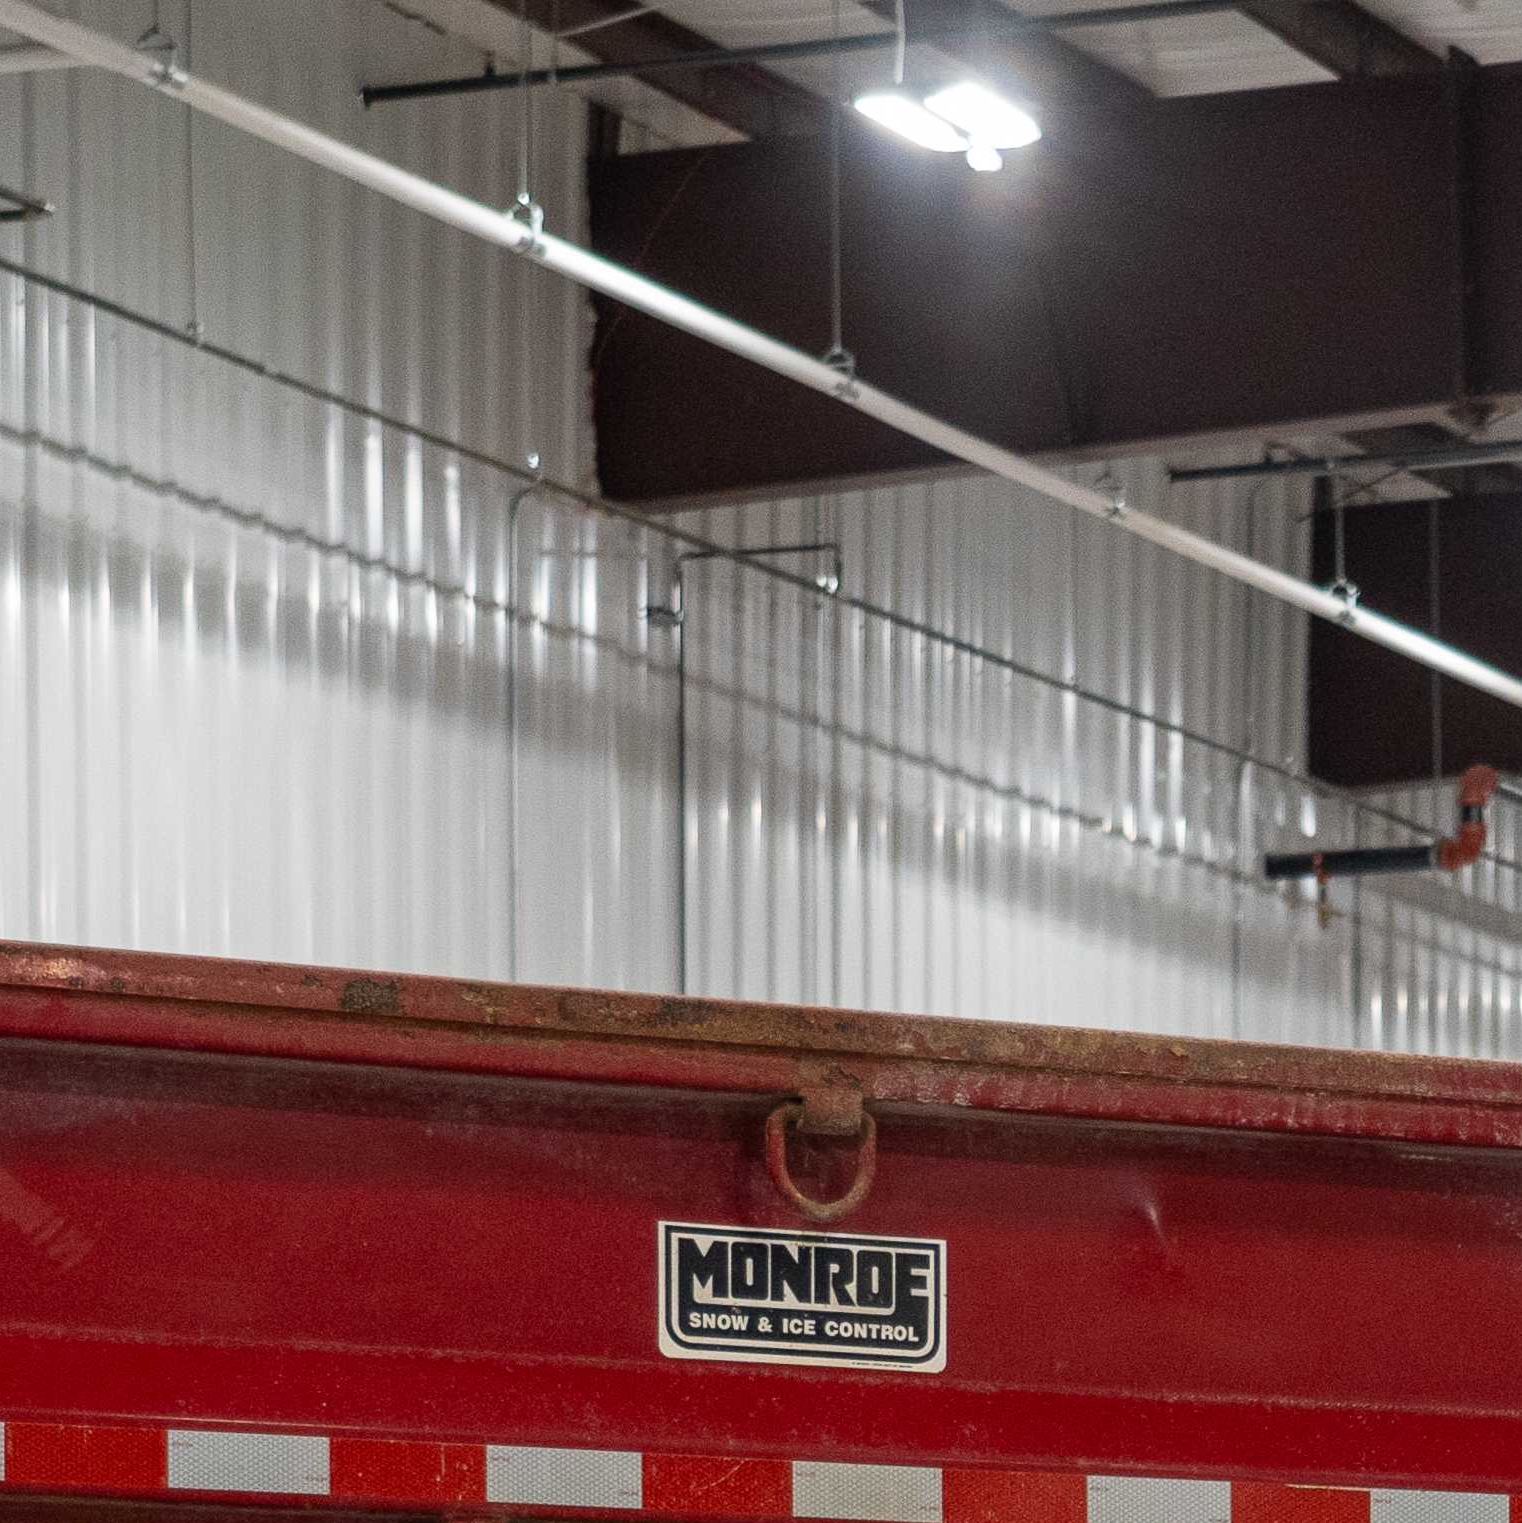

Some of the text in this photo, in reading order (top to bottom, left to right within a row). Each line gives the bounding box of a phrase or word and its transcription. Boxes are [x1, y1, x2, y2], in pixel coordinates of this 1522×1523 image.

[678, 1238, 930, 1310] MONROE
[688, 1311, 919, 1342] SNOW & ICE CONTROL
